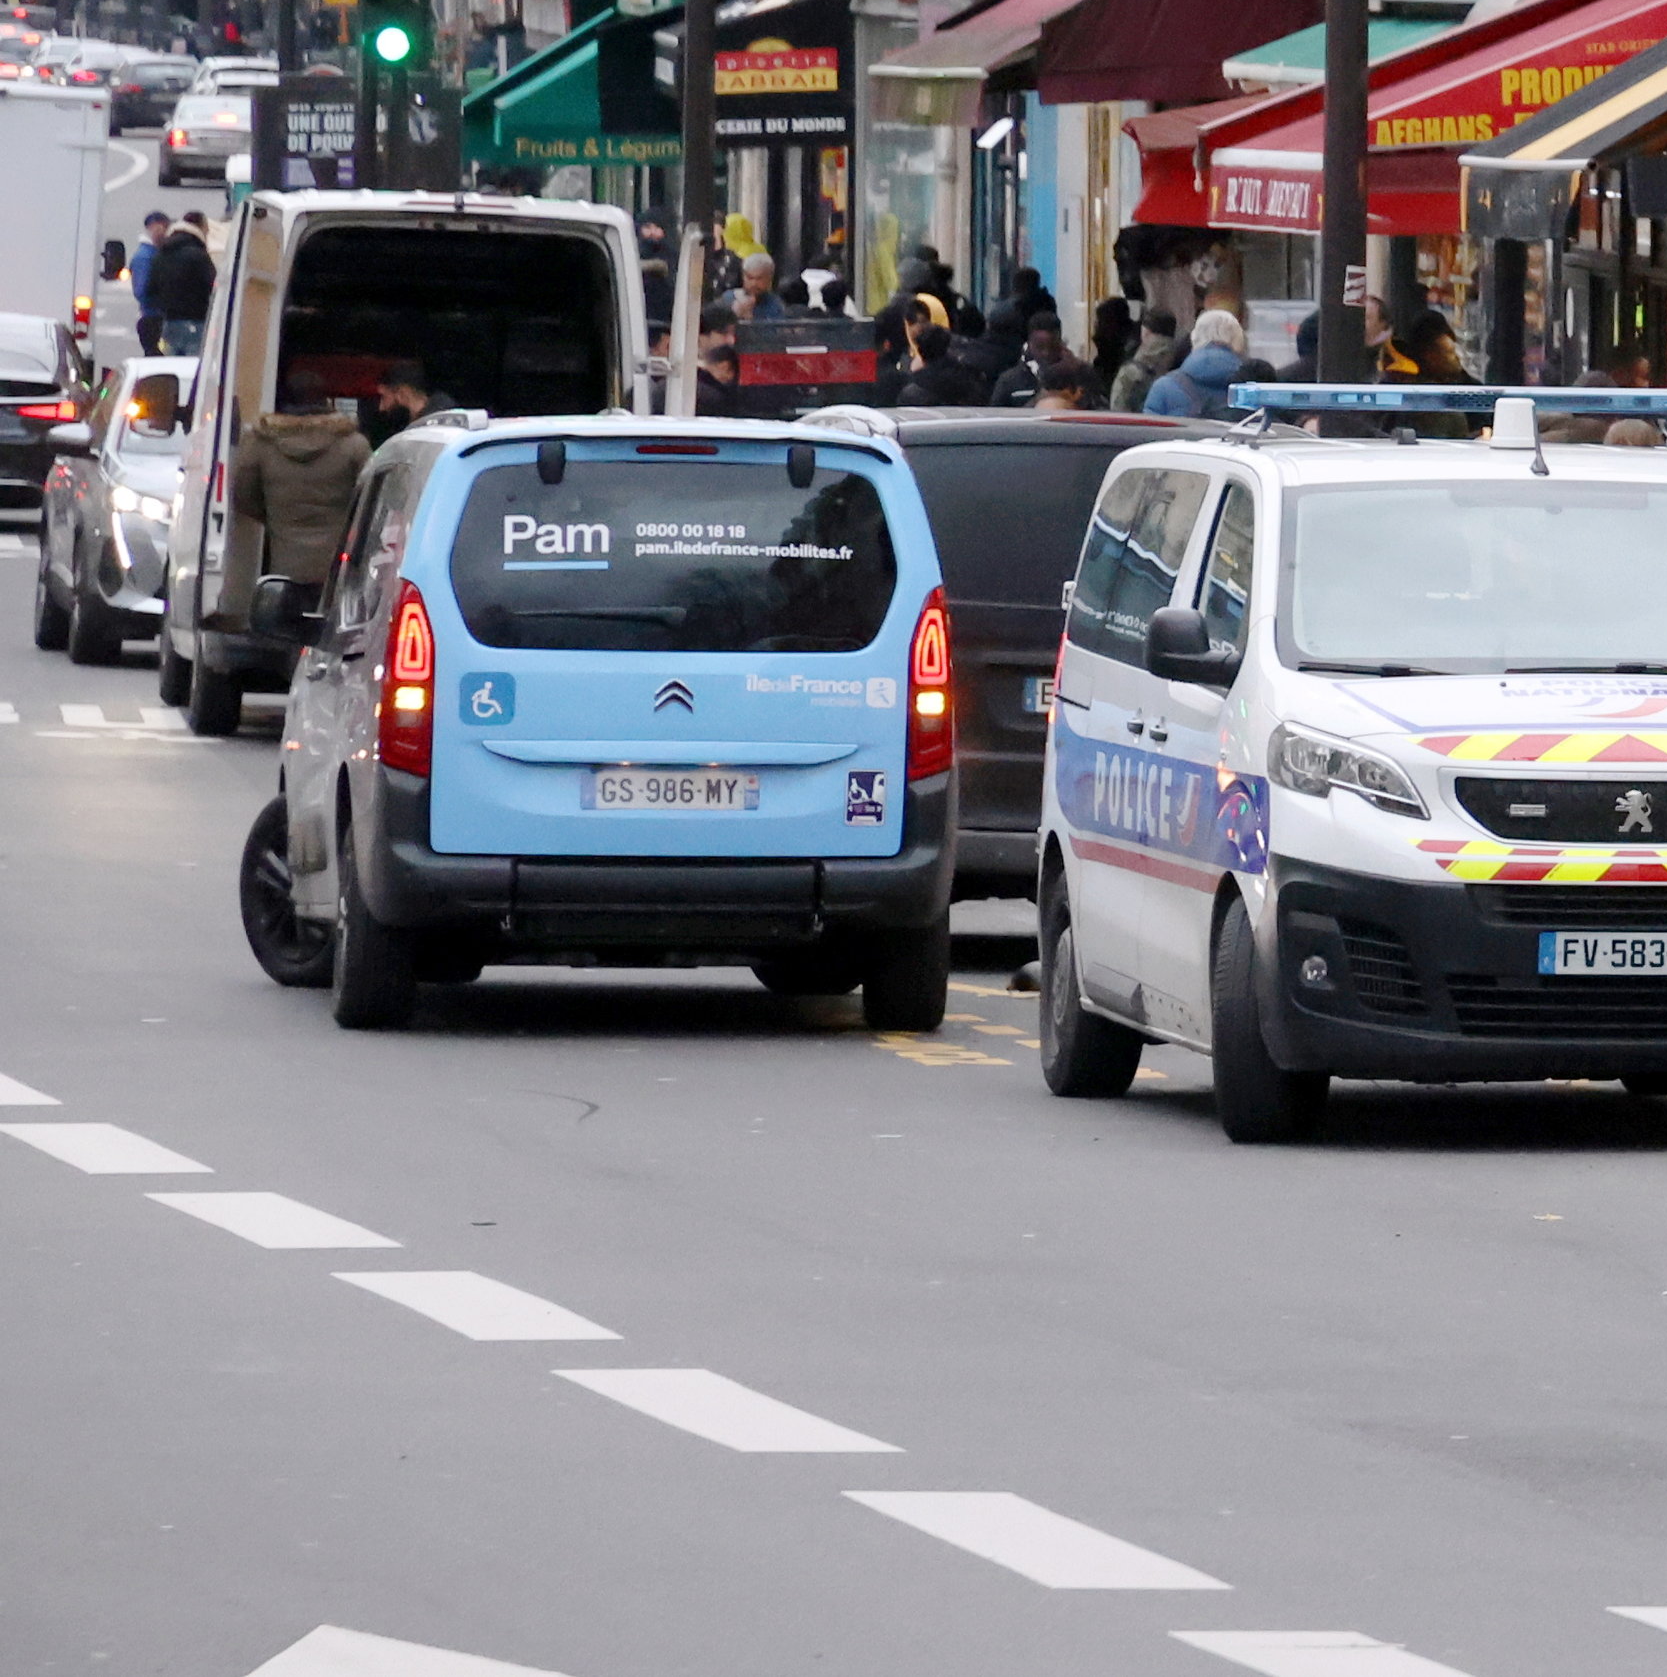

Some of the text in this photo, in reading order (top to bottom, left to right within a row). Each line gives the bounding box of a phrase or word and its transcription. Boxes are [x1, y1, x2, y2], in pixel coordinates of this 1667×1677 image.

[715, 117, 846, 135] CERIE DU MONDE
[1375, 113, 1493, 146] AFGHANS
[515, 135, 682, 163] Fruits & Légum
[503, 514, 610, 555] Pam
[635, 523, 746, 539] 0800 00 18 18
[635, 540, 854, 561] pam.iledefrance-mobilites.fr
[600, 778, 739, 805] GS-986-MY
[1093, 750, 1173, 841] POLICE
